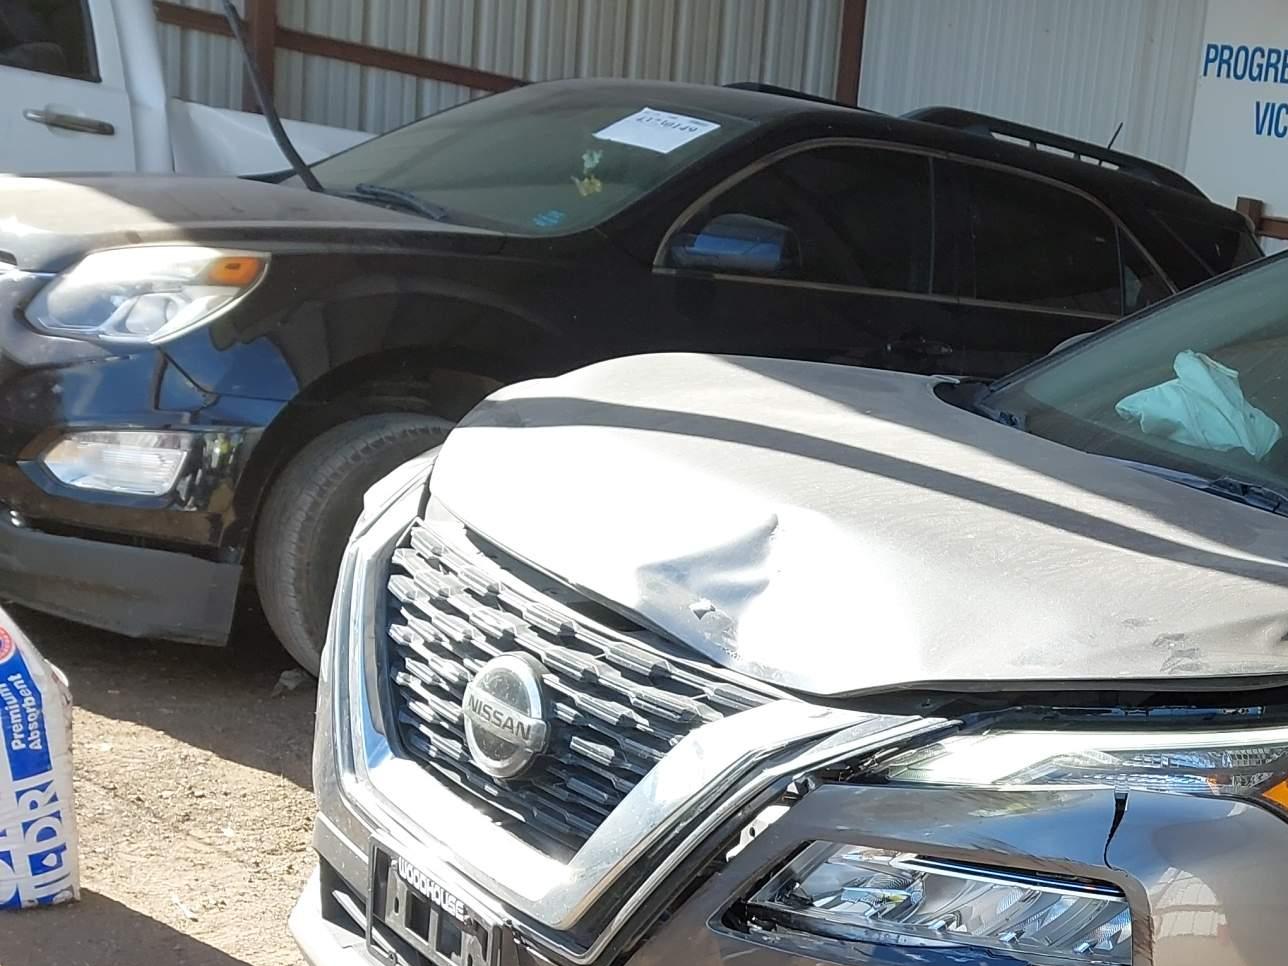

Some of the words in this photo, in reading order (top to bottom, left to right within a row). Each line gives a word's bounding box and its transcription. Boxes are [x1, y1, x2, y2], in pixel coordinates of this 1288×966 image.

[0, 683, 26, 750] Premium
[8, 673, 42, 750] Absorbent
[468, 695, 531, 740] NISSAN
[399, 857, 466, 921] WOODHOUSE
